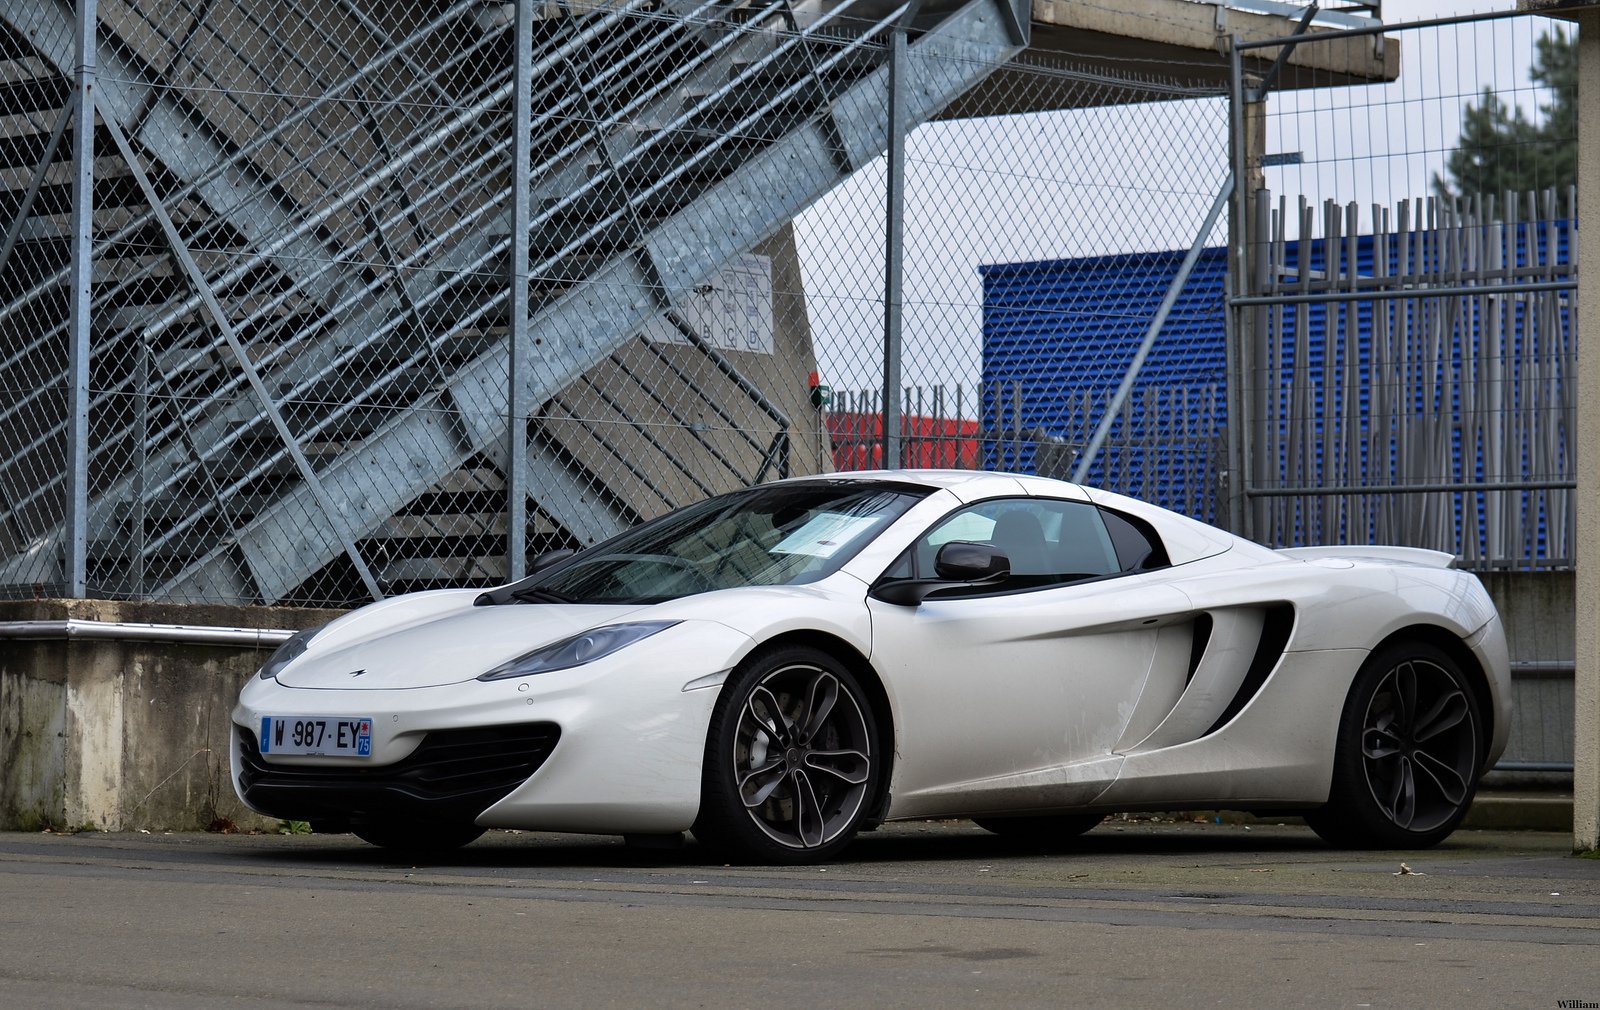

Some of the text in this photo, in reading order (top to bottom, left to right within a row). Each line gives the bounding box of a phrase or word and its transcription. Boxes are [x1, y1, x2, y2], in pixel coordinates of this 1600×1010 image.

[704, 325, 711, 338] B
[727, 328, 735, 341] C
[337, 721, 361, 748] EY
[359, 738, 370, 752] 75
